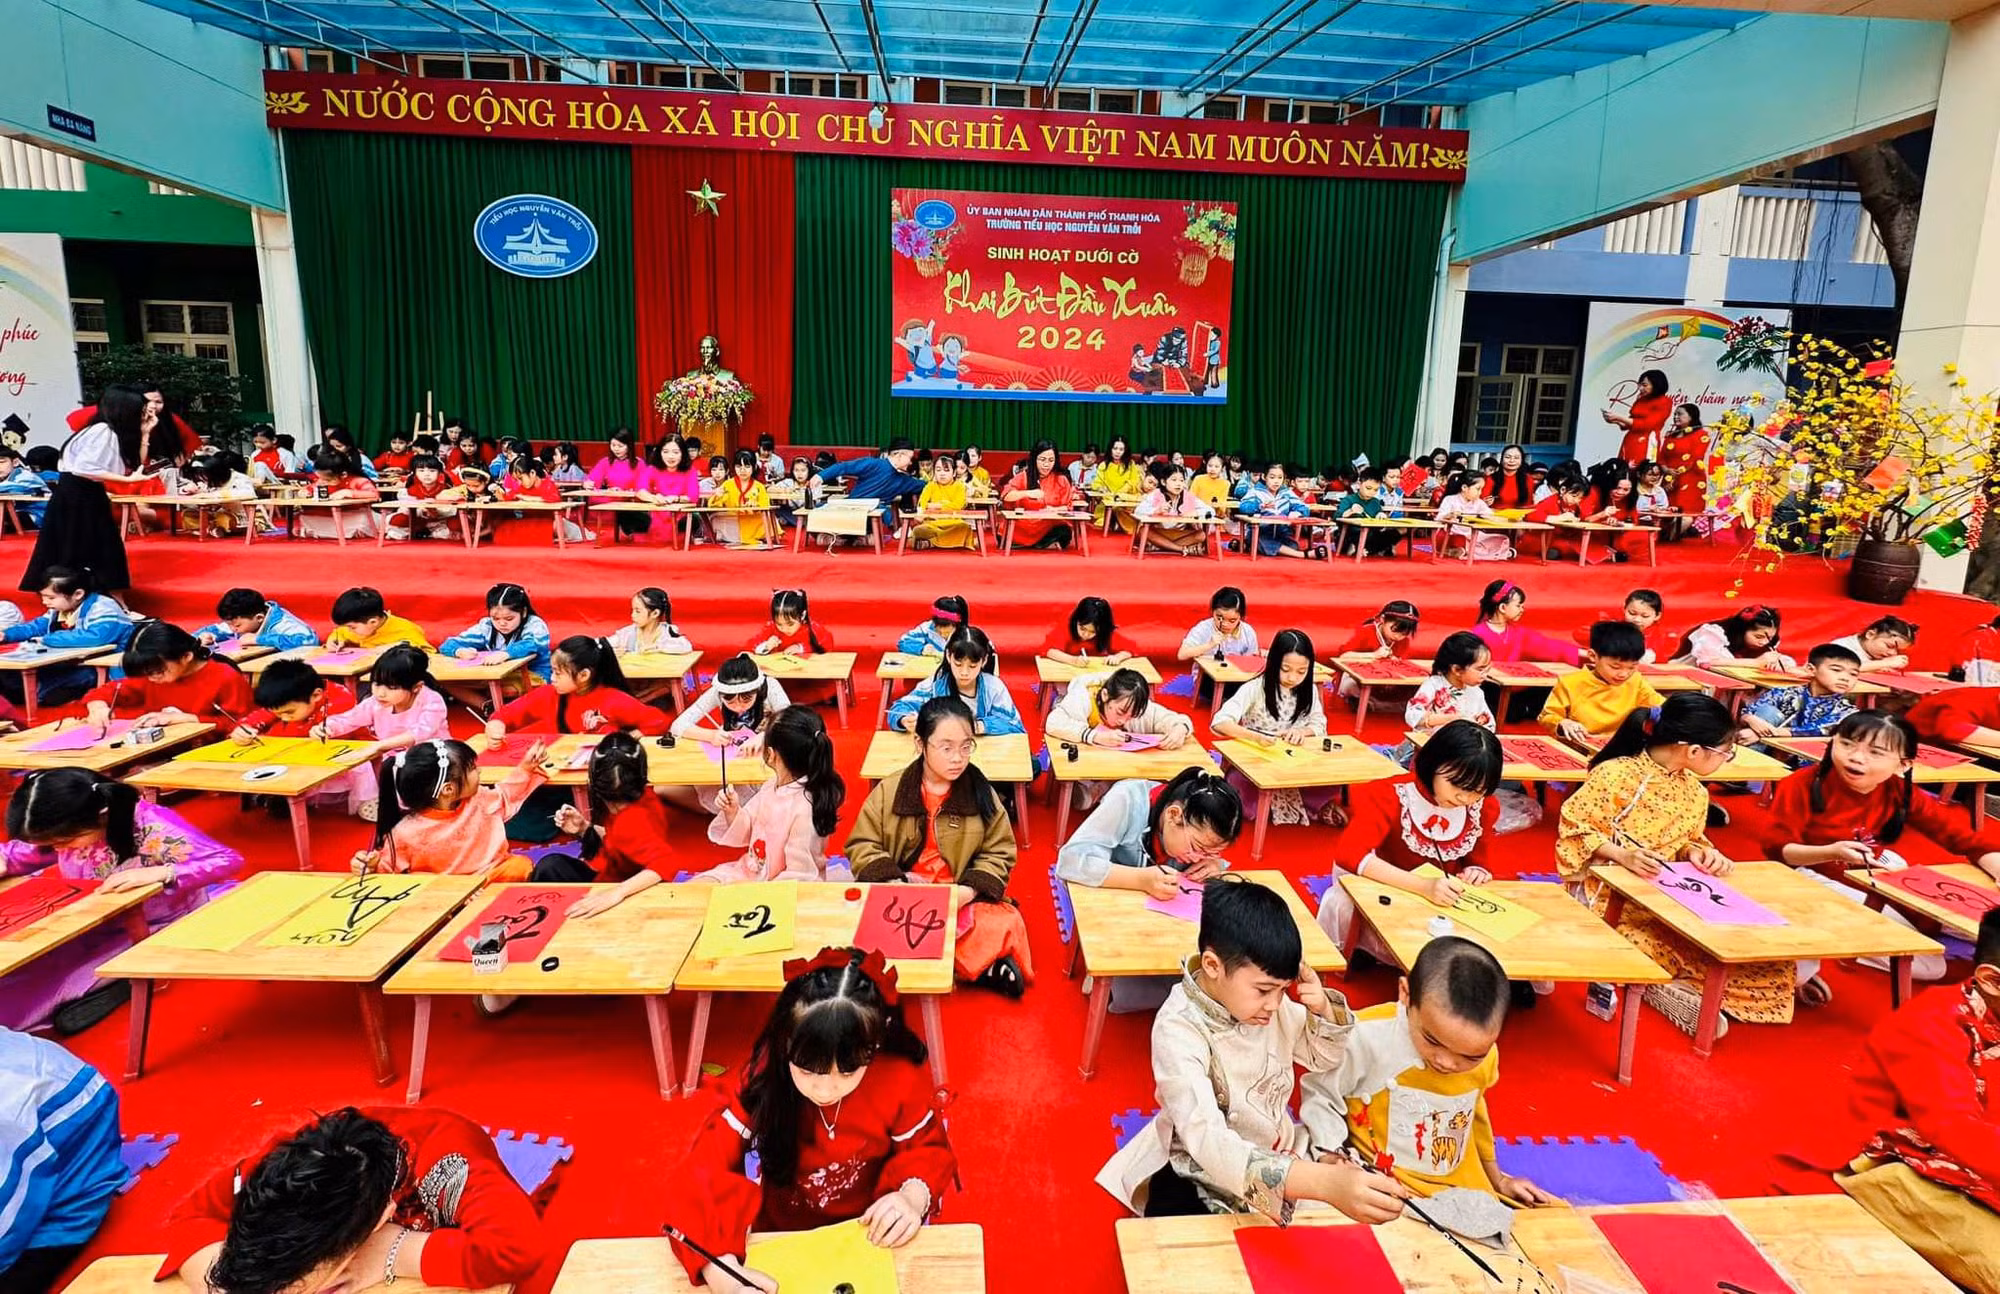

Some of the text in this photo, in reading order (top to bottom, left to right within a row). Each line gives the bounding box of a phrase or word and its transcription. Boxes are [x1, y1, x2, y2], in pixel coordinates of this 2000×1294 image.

[321, 79, 1430, 169] NƯỚC CỘNG HÒA XÃ HỘI CHỦ NGHĨA VIỆT NAM MUÔN NĂM!
[967, 203, 1161, 223] ỦY BAN NHÂN DÂN THÀNH PHỐ THANH HÓA
[986, 217, 1022, 230] TRƯỜNG
[1023, 217, 1043, 230] TIỂU
[1045, 220, 1063, 233] HỌC
[1065, 221, 1101, 233] NGUYỄN
[1102, 222, 1120, 234] VĂN
[987, 247, 1139, 264] SINH HOẠT DƯỚI CỜ
[944, 269, 1178, 320] Khai Bút Đầu Xuân
[1017, 325, 1106, 351] 2024
[1695, 384, 1725, 406] chăm
[474, 958, 499, 966] Queen
